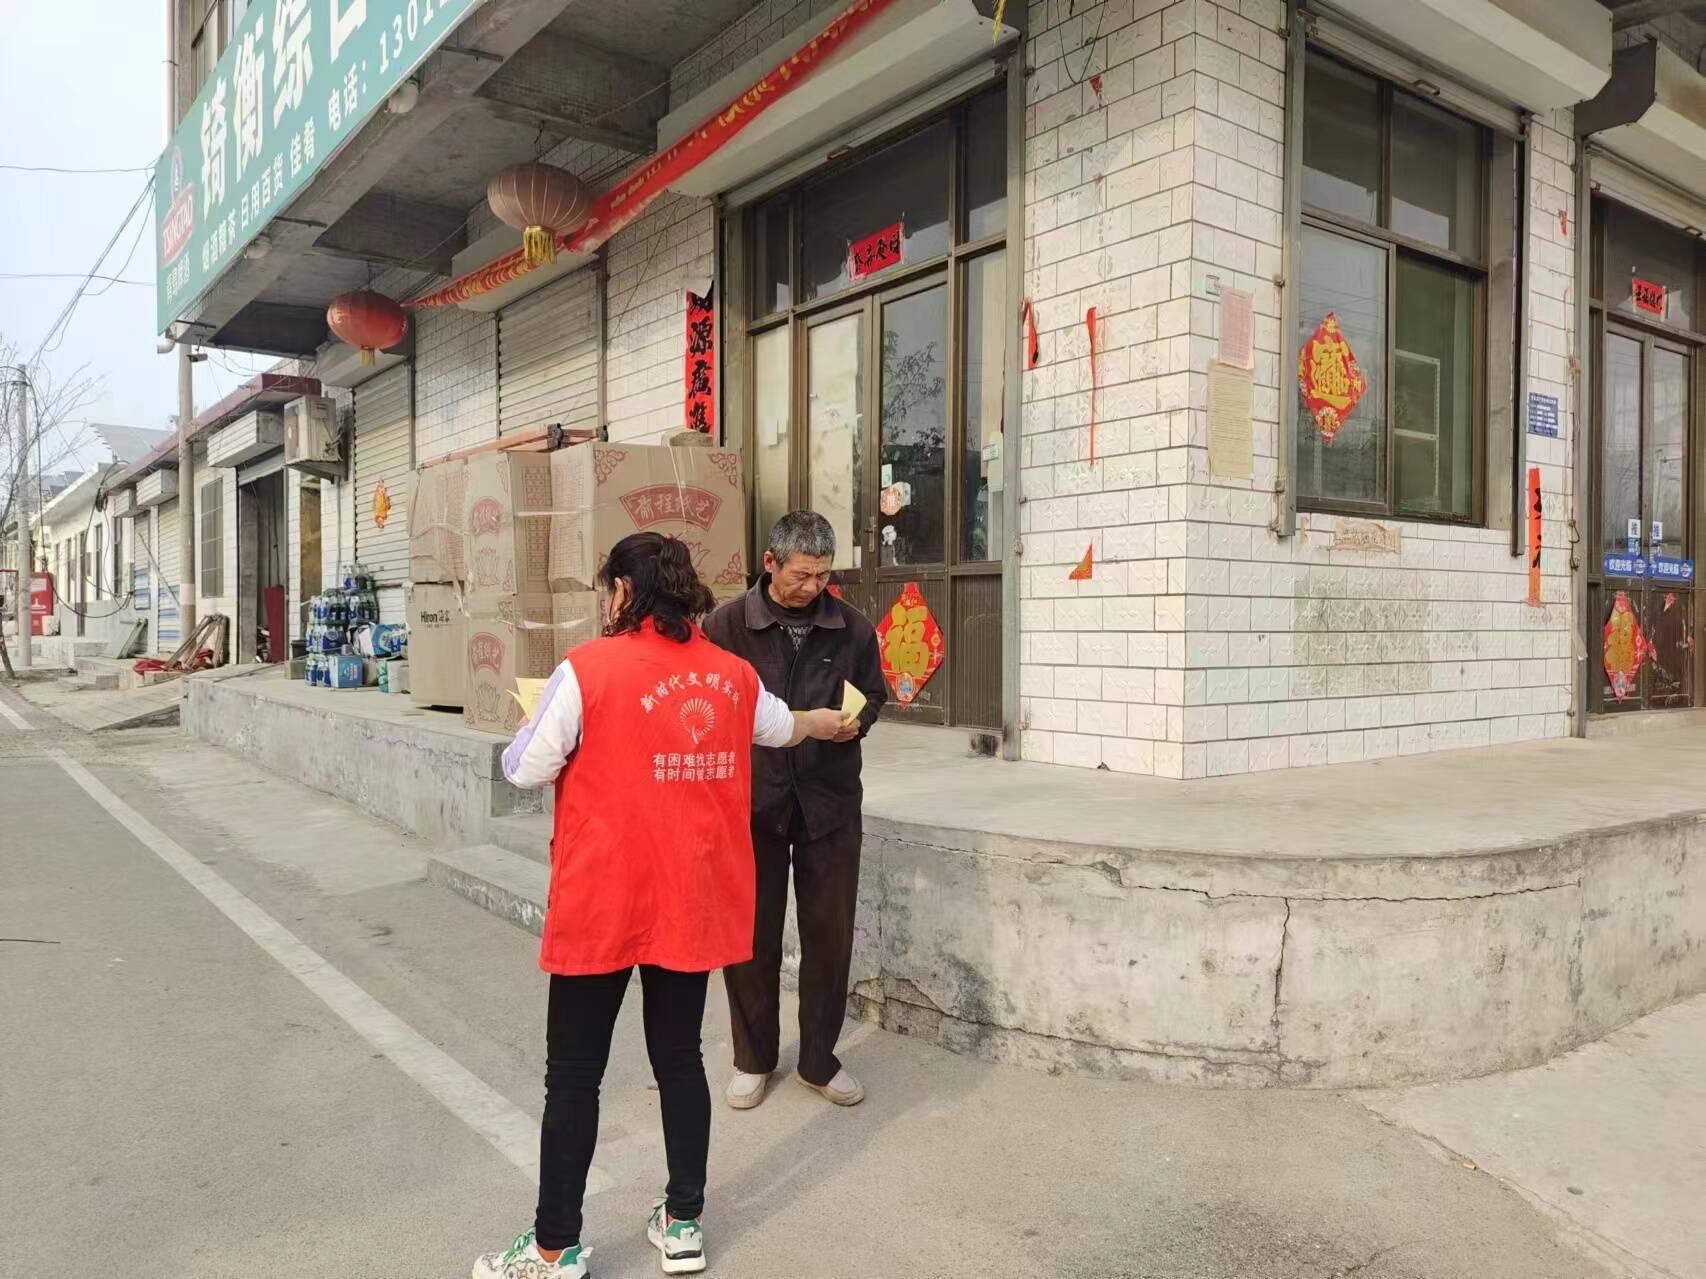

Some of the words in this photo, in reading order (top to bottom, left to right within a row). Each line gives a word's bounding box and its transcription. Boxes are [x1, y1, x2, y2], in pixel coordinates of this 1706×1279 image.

[241, 152, 283, 231] 日用百货
[379, 0, 449, 75] 1301
[653, 751, 737, 768] 有困难找志愿者
